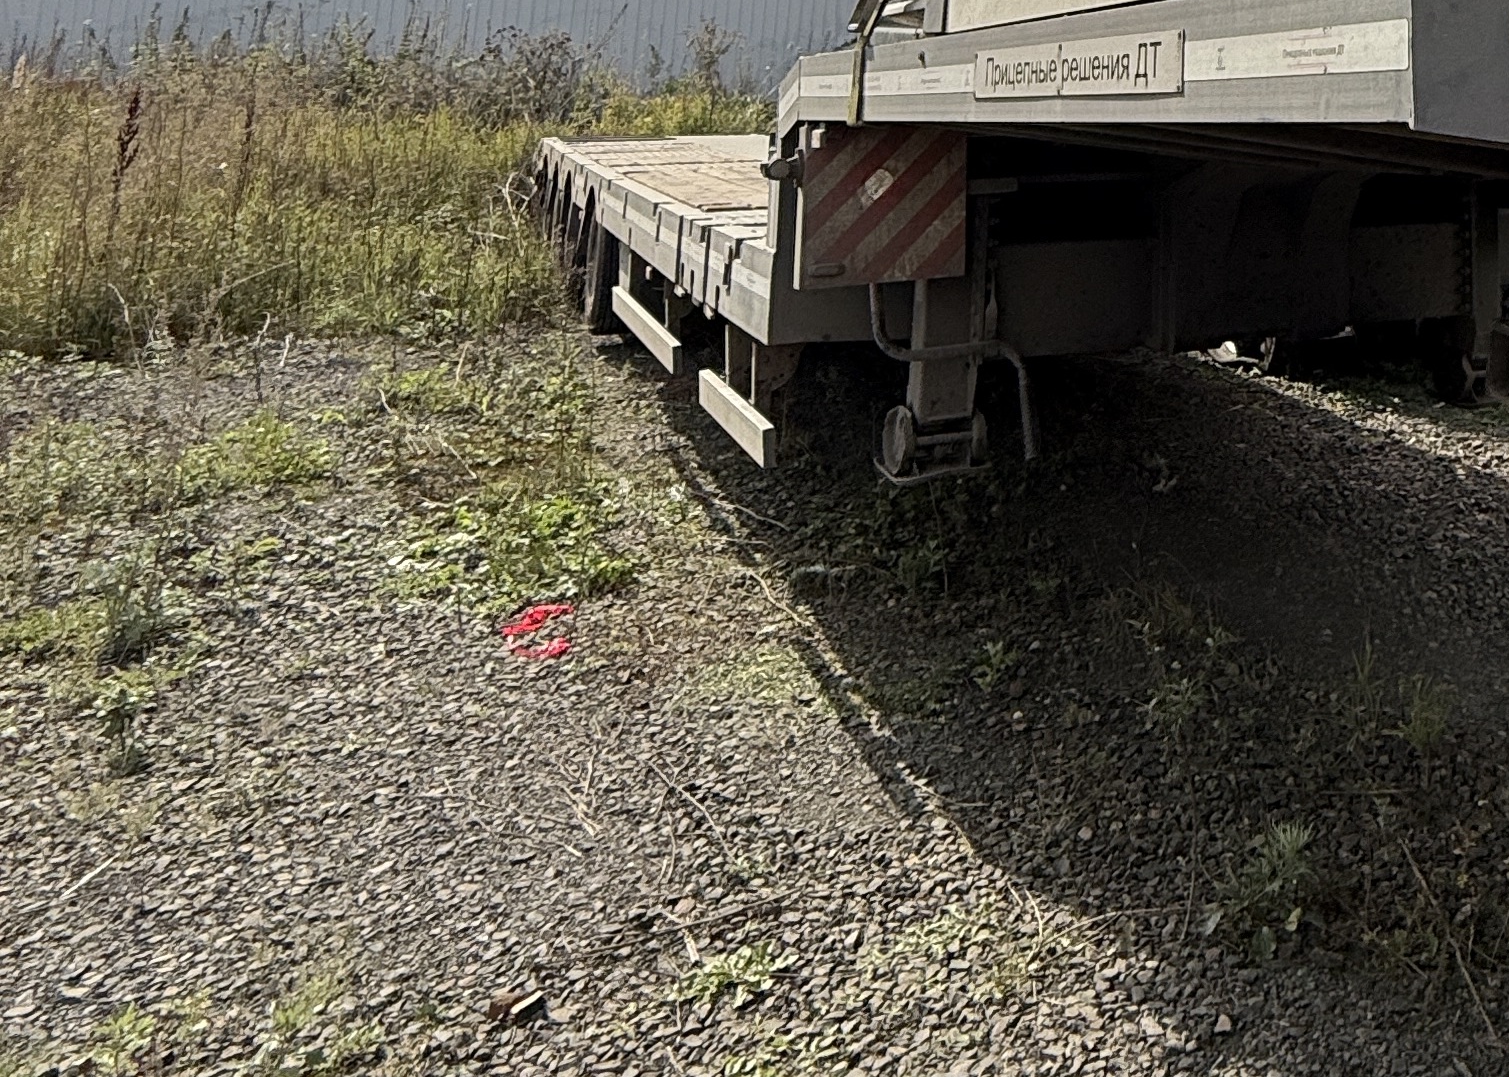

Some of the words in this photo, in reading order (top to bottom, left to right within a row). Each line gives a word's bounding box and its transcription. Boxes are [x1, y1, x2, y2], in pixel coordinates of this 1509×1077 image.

[985, 56, 1058, 92] Прицепные
[1060, 50, 1130, 90] решения
[1134, 41, 1163, 88] ДТ
